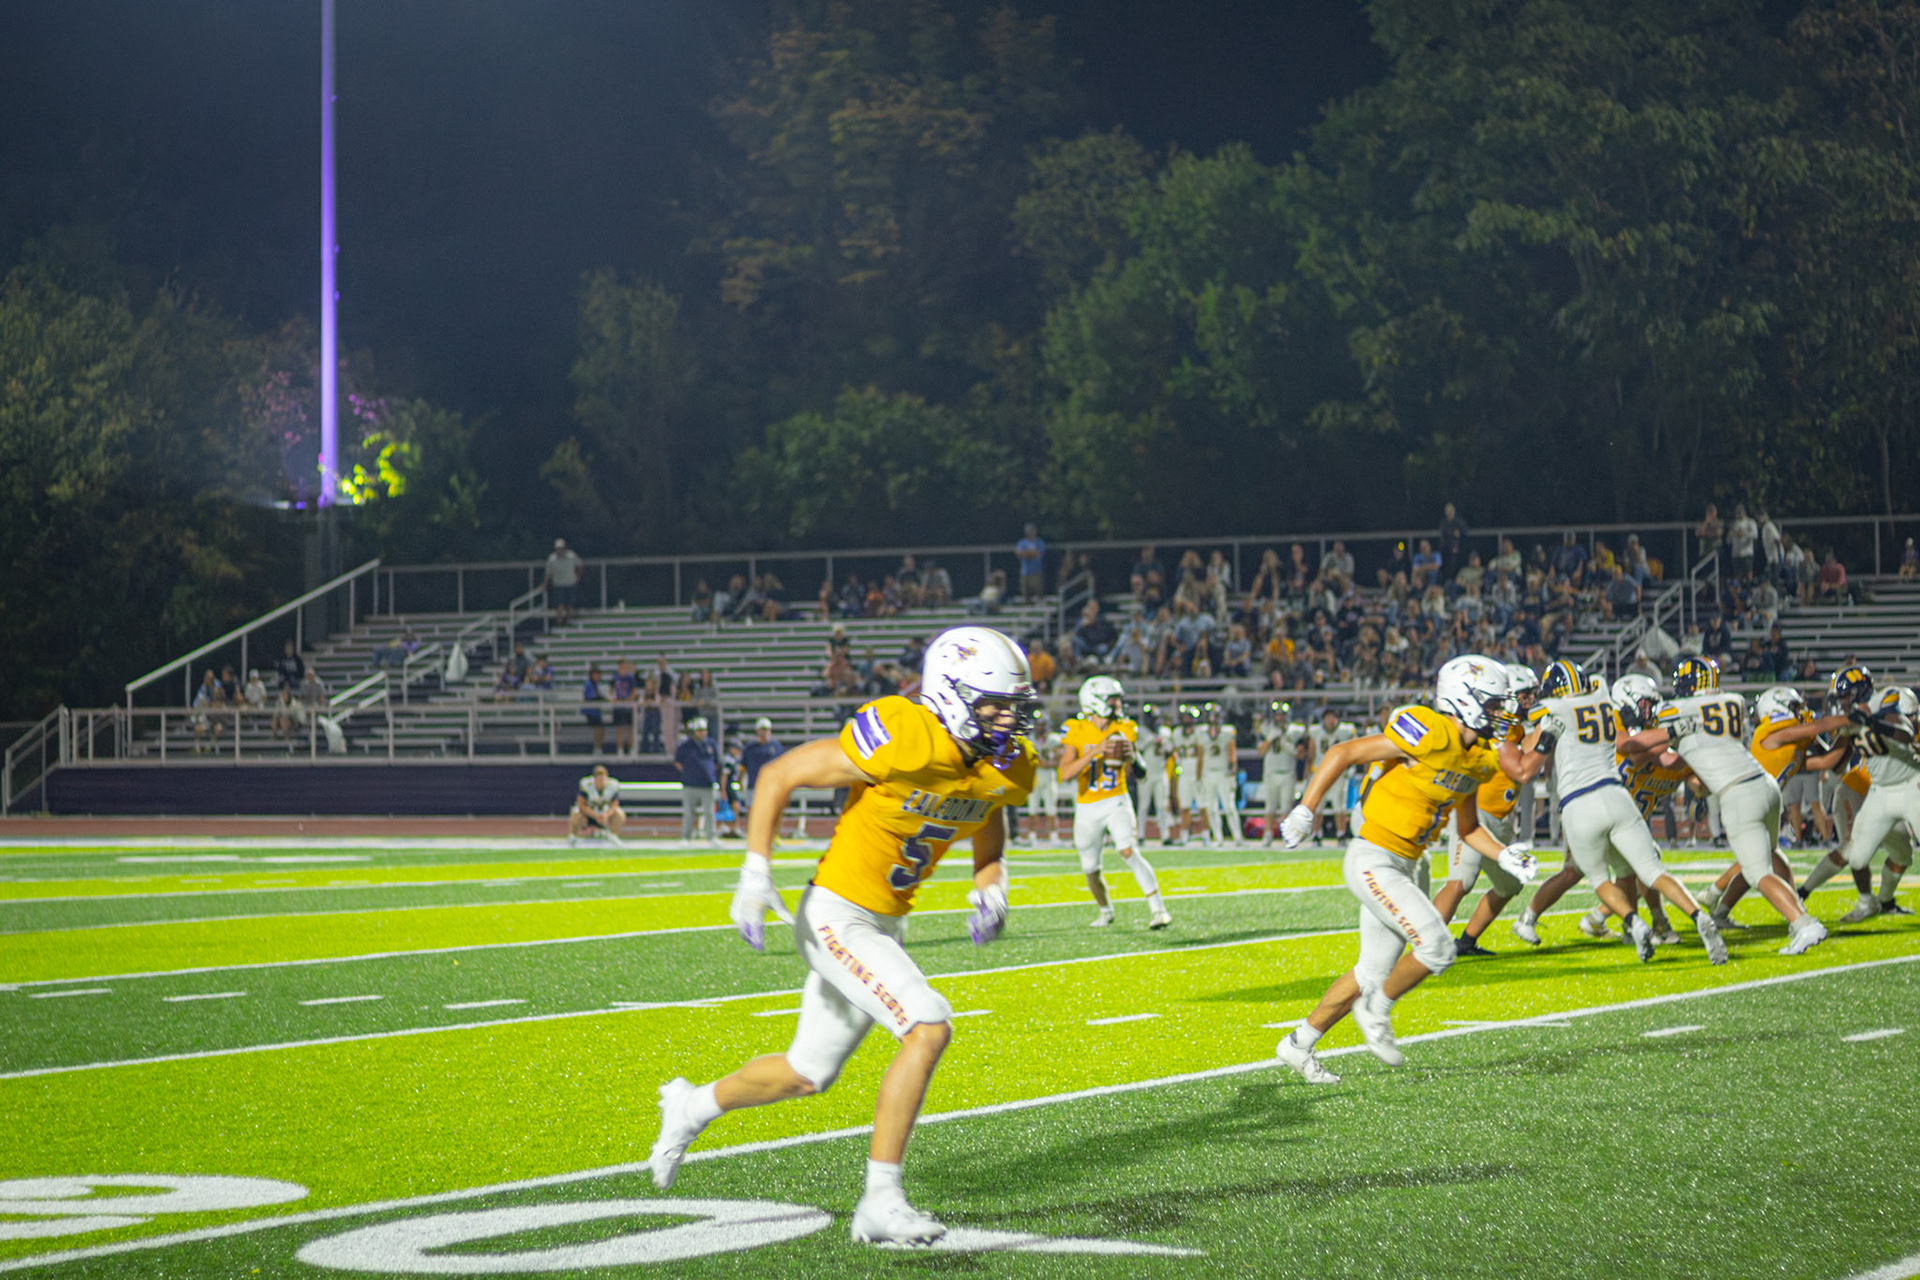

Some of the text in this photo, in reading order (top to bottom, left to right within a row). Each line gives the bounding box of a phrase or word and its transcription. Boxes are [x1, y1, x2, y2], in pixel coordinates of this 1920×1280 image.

[1574, 701, 1616, 744] 56
[1699, 701, 1742, 739] 58
[888, 821, 959, 890] 5
[818, 924, 909, 1027] FIGHTING SCOTS
